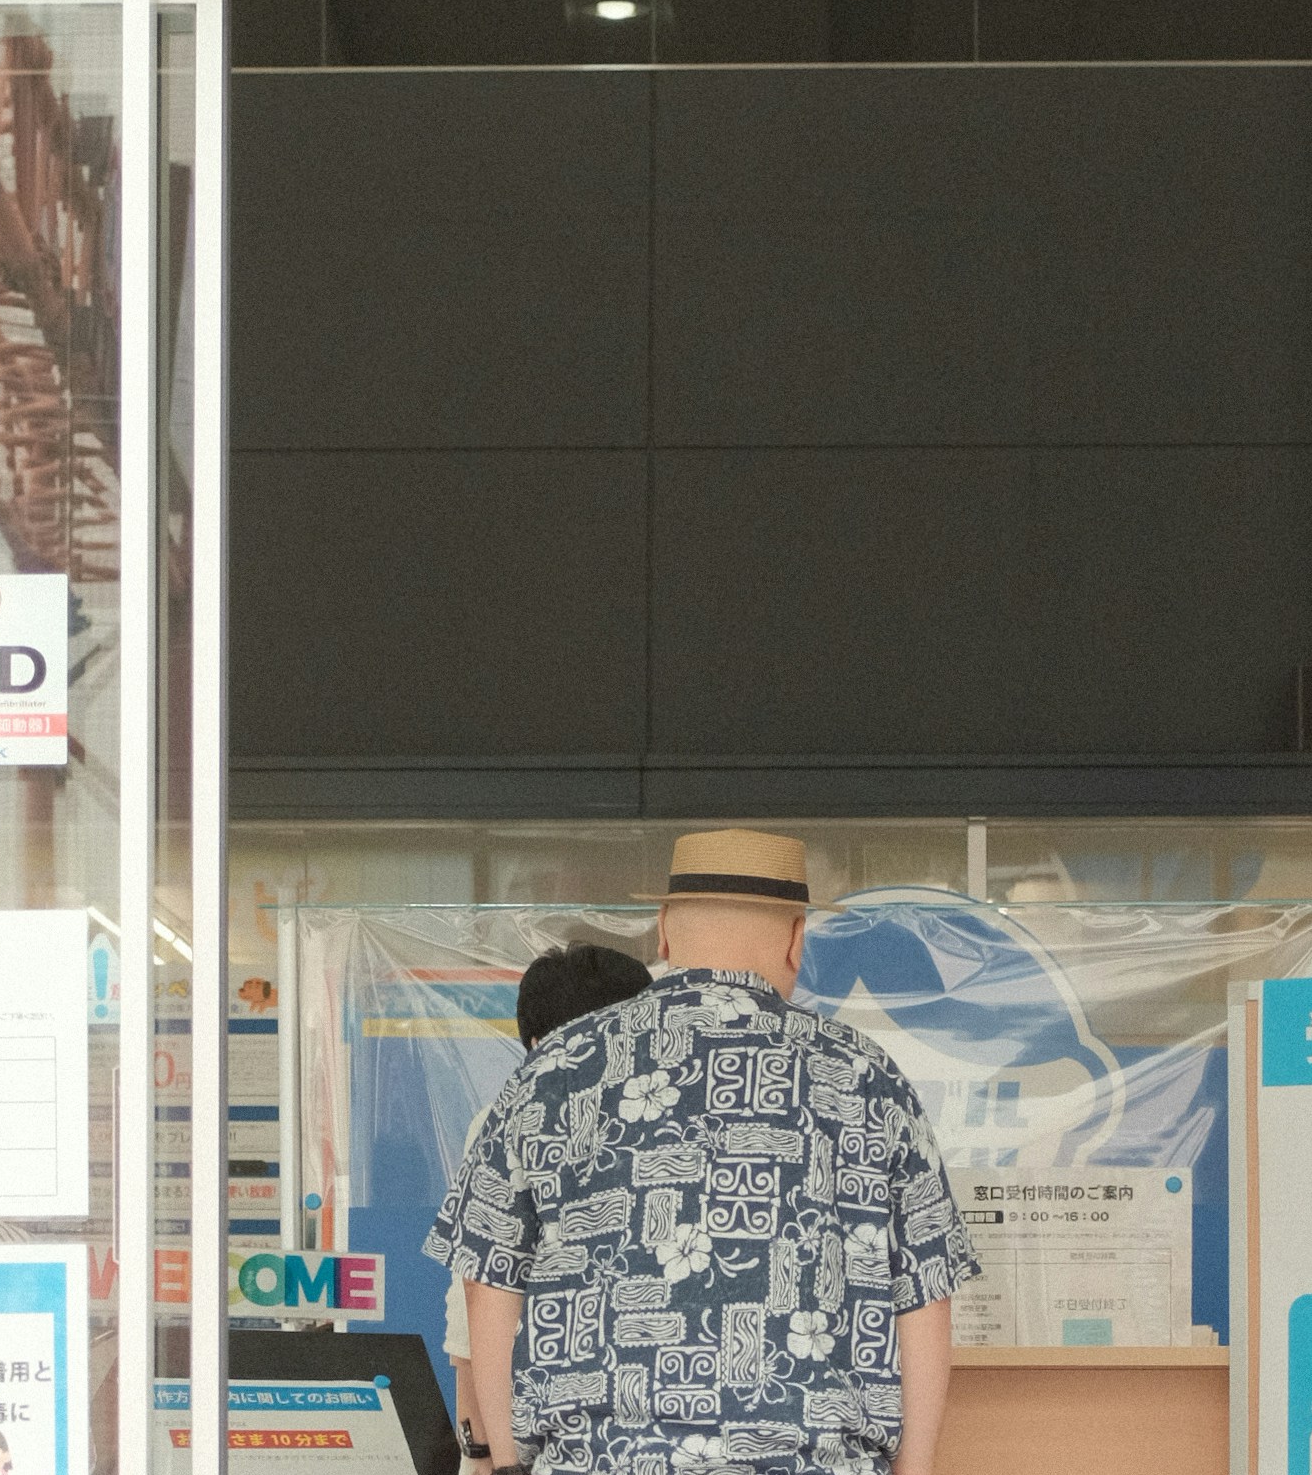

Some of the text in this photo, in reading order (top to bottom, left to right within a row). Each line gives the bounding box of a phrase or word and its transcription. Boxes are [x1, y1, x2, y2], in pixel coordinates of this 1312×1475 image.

[973, 1185, 1133, 1201] 窓口受付時間のご案内
